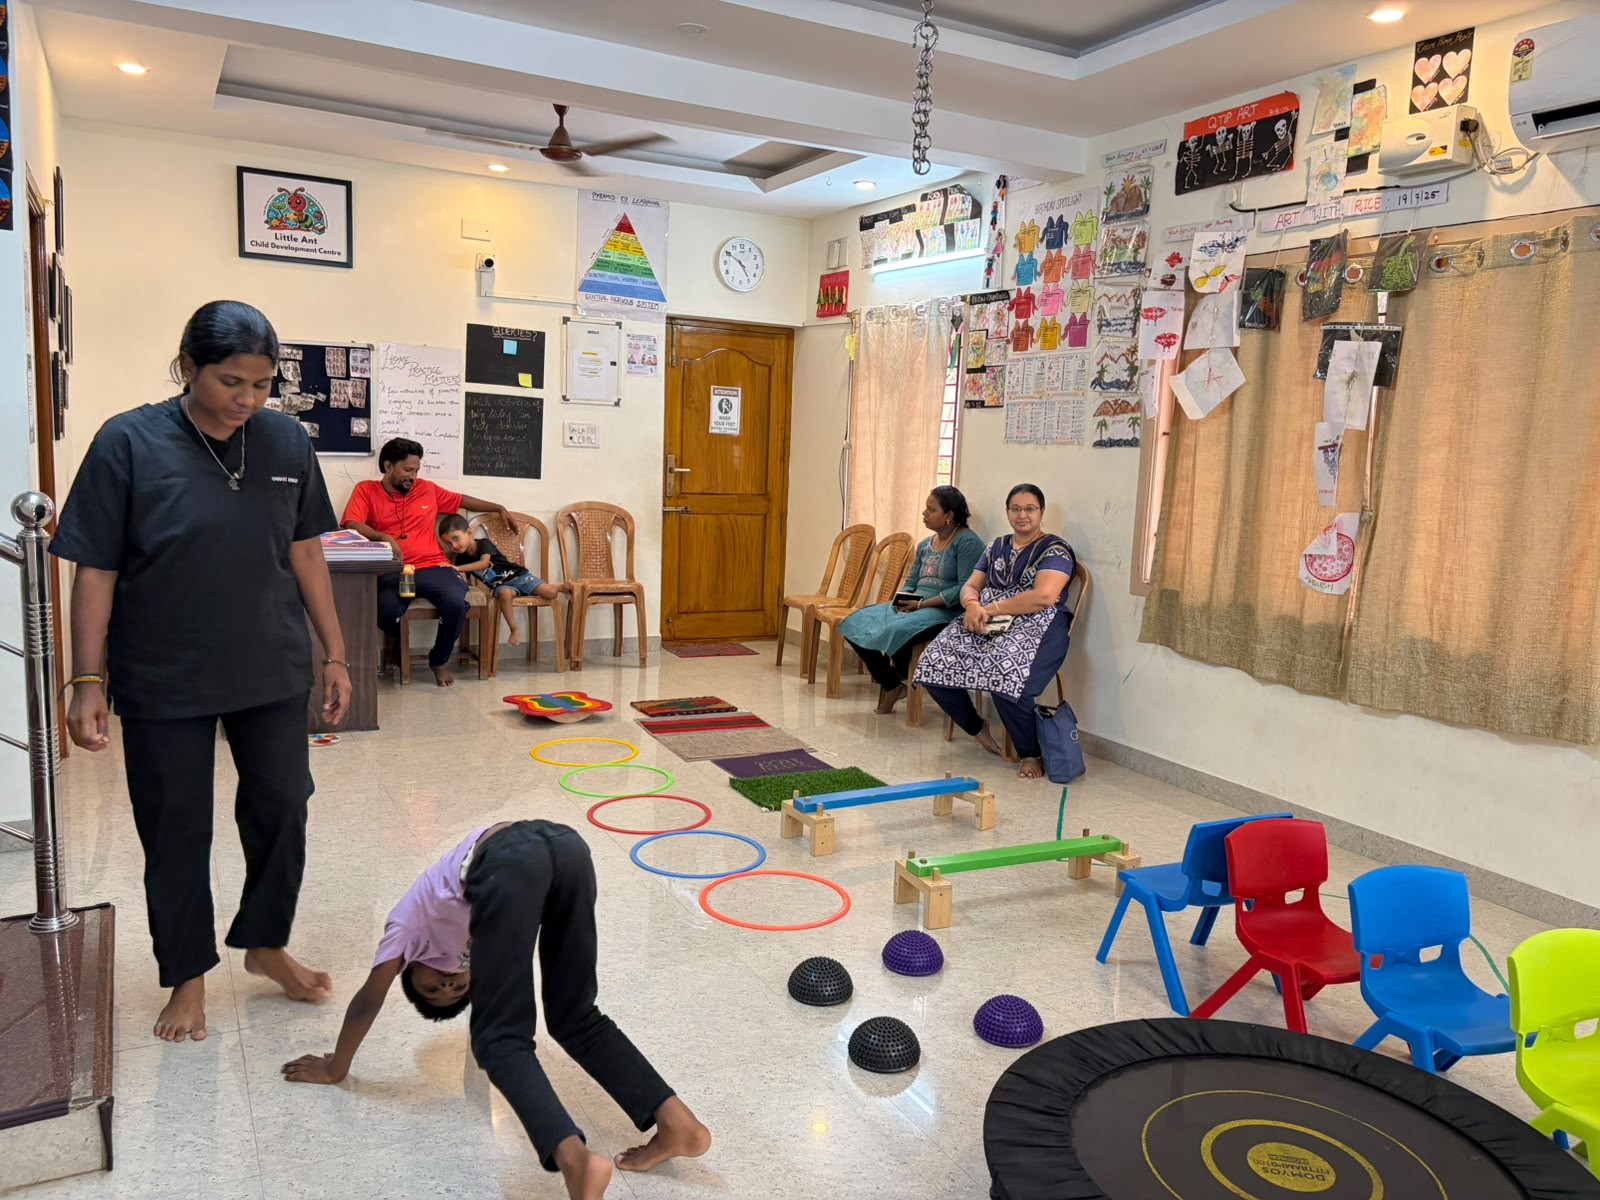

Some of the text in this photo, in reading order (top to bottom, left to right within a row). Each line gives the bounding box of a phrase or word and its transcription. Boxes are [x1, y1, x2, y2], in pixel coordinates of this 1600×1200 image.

[1208, 103, 1259, 129] QTIP ART
[1056, 194, 1083, 210] SPOTLIGHT
[1274, 211, 1300, 229] ART
[1311, 204, 1342, 221] WITH
[274, 233, 318, 245] Little Ant
[250, 240, 342, 256] Child Development Centre
[585, 293, 660, 310] CENTRAL NERVOUS SYSTEM
[492, 326, 538, 342] QUERIES?
[383, 345, 410, 369] HOME
[405, 362, 443, 376] PRACTICE
[424, 374, 461, 383] MATTERS
[1261, 1166, 1326, 1182] DOMYOS
